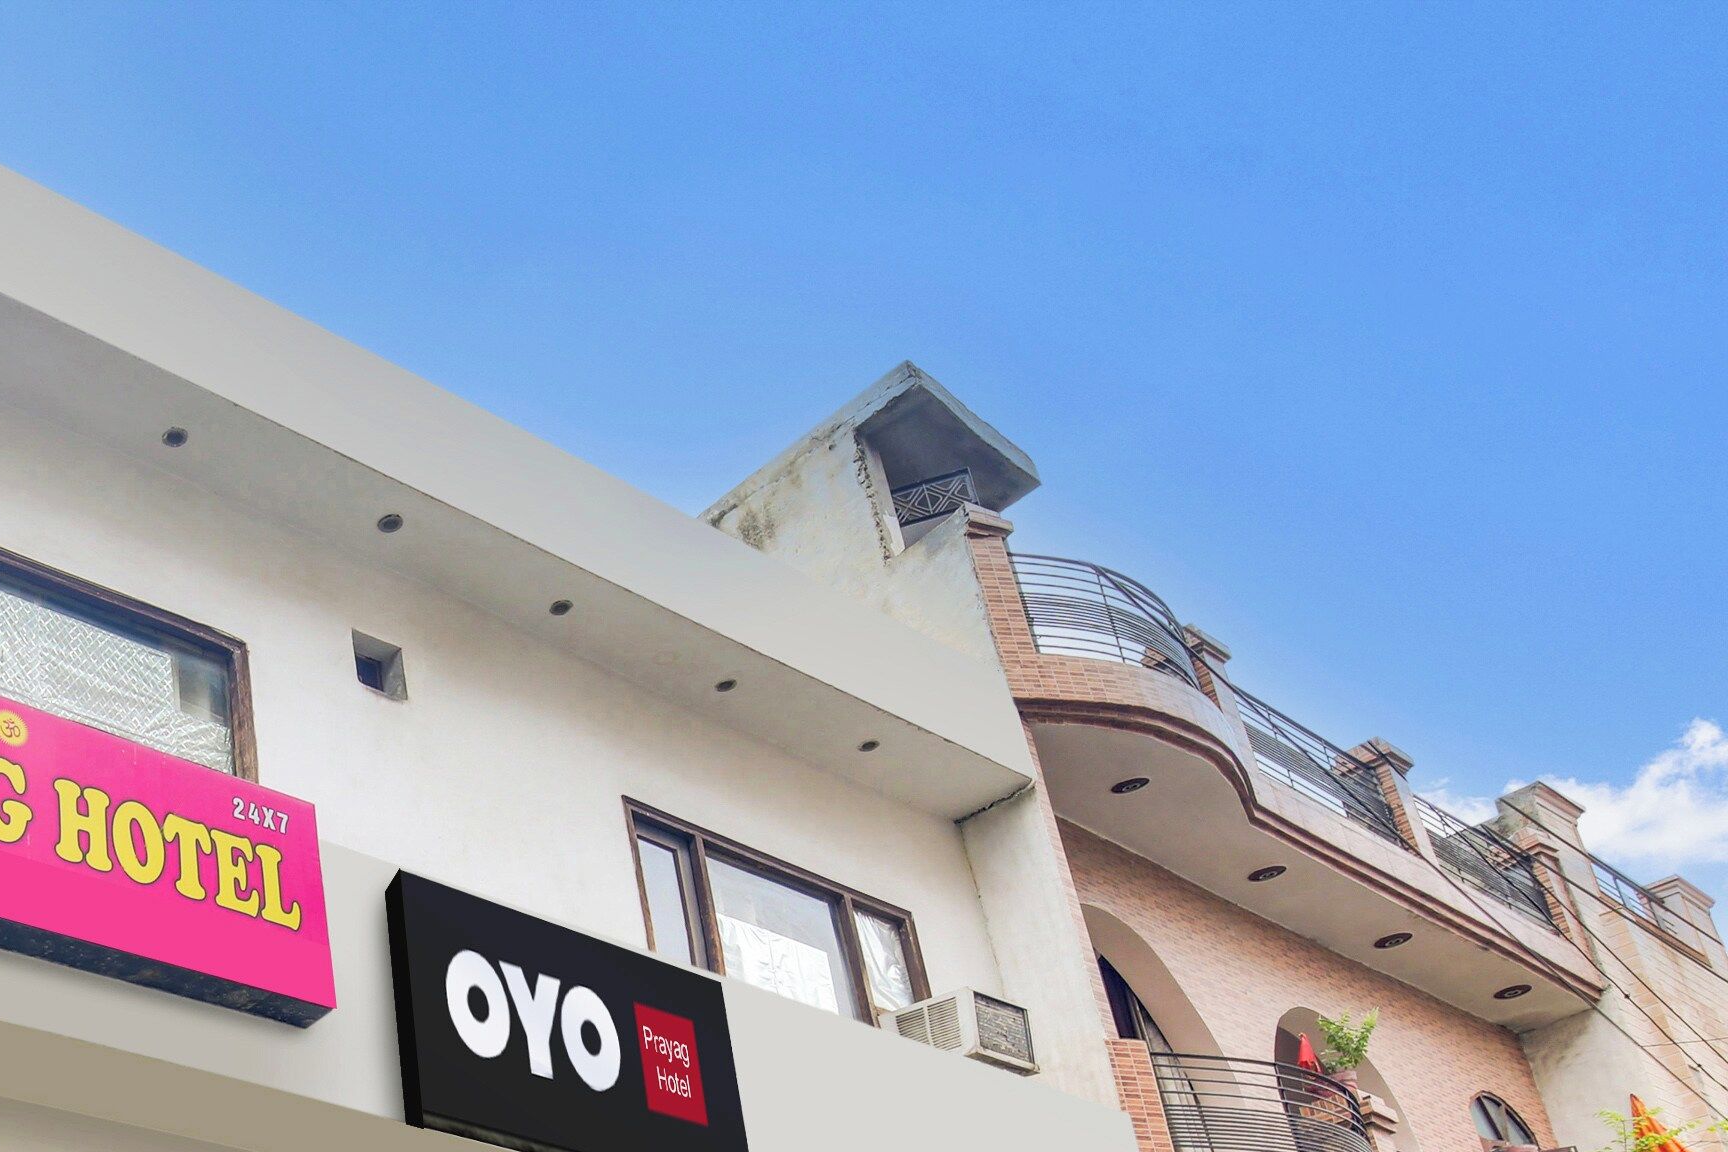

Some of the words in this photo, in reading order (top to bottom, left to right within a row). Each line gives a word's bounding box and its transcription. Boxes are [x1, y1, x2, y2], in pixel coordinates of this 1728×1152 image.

[232, 796, 290, 835] 24X7
[53, 777, 304, 931] HOTEL
[445, 949, 622, 1093] OYO
[642, 1025, 691, 1068] Prayag
[656, 1065, 693, 1099] Hotel
